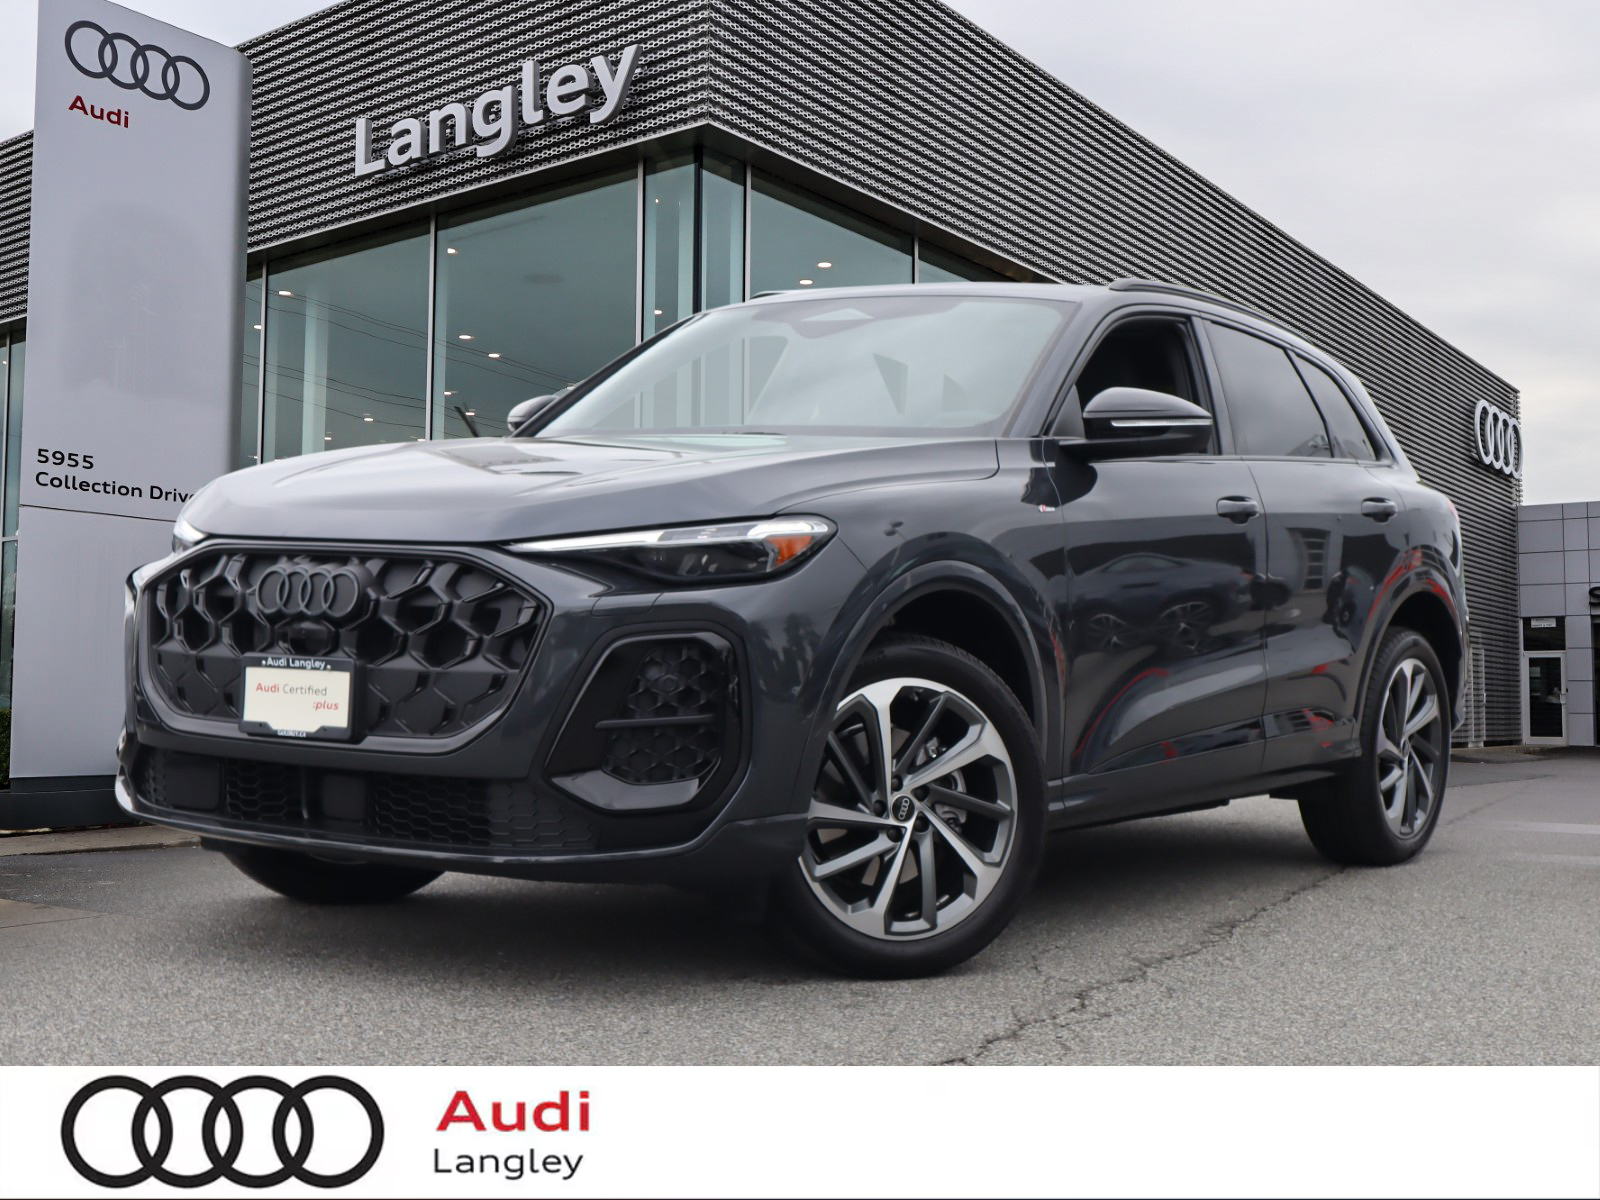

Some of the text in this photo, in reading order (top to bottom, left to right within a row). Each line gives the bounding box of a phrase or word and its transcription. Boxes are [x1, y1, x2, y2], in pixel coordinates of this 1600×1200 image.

[68, 95, 129, 128] Audi
[355, 43, 643, 177] Langley
[37, 448, 94, 469] 5955
[35, 471, 195, 503] Collection Driv
[266, 657, 325, 670] Audi Langley
[256, 682, 328, 696] Audi Certified
